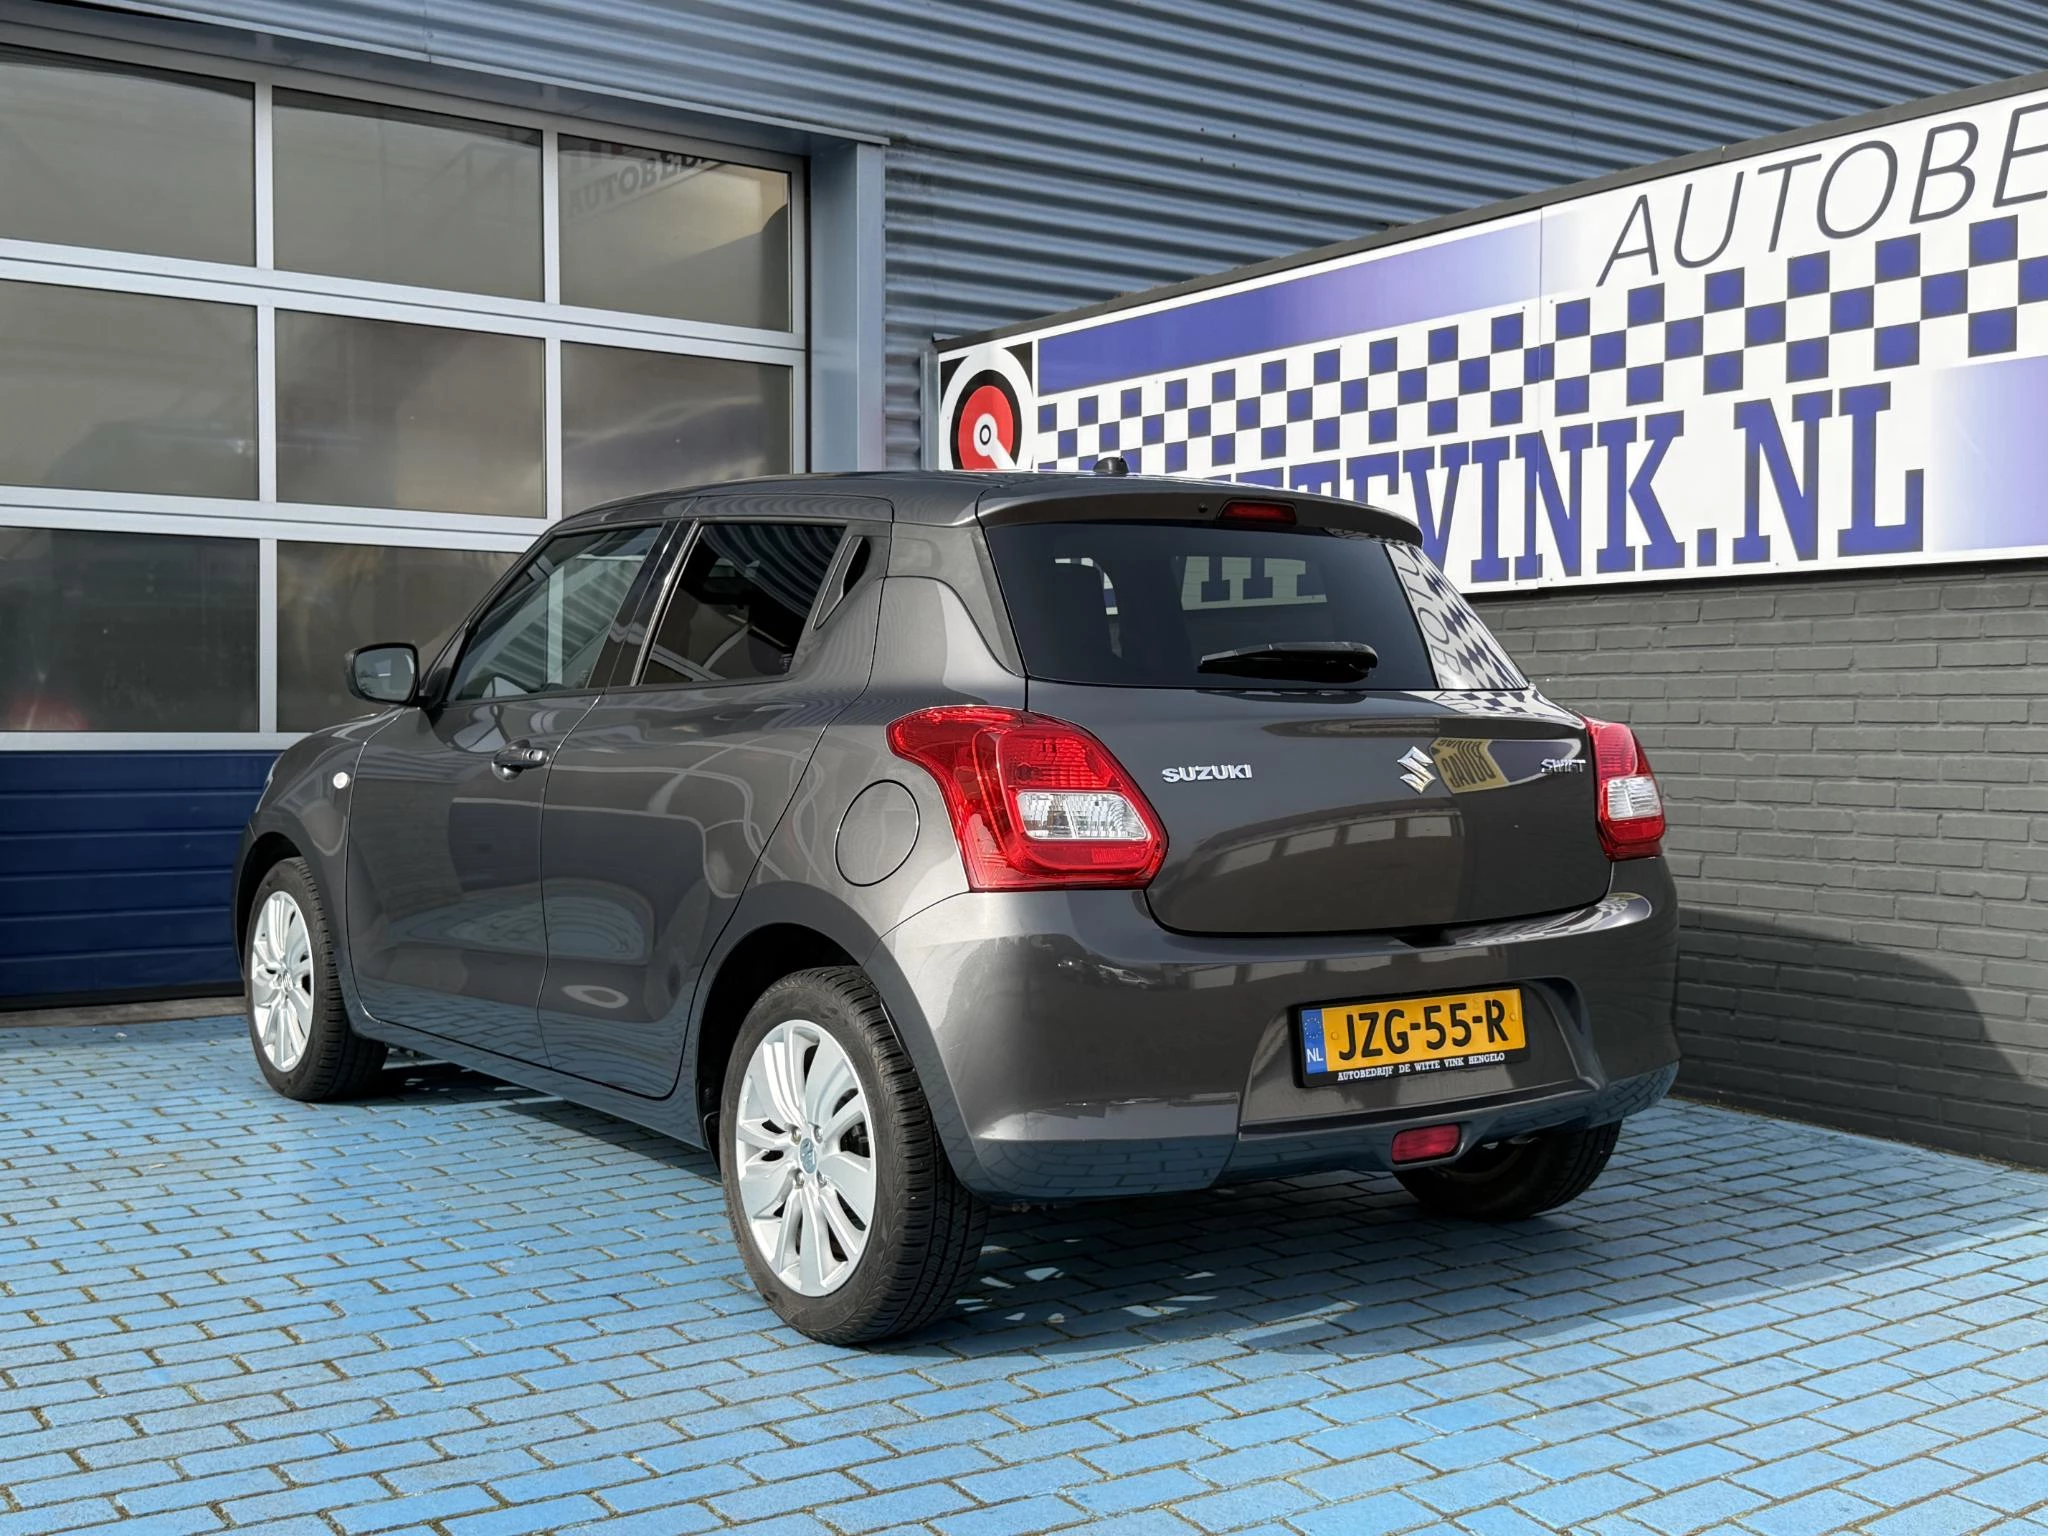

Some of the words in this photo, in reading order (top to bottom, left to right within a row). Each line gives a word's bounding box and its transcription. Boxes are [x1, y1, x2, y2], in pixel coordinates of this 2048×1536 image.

[1162, 764, 1253, 783] SUZUKI
[1541, 758, 1586, 774] SWIFT
[1338, 999, 1509, 1061] JZG-55-R
[1306, 1047, 1323, 1063] NL
[1337, 1066, 1394, 1081] AUTOBEDRIJF
[1398, 1064, 1411, 1074] DE
[1414, 1060, 1440, 1071] WITTE
[1444, 1057, 1464, 1068] VINK
[1468, 1052, 1506, 1065] HENGELO
